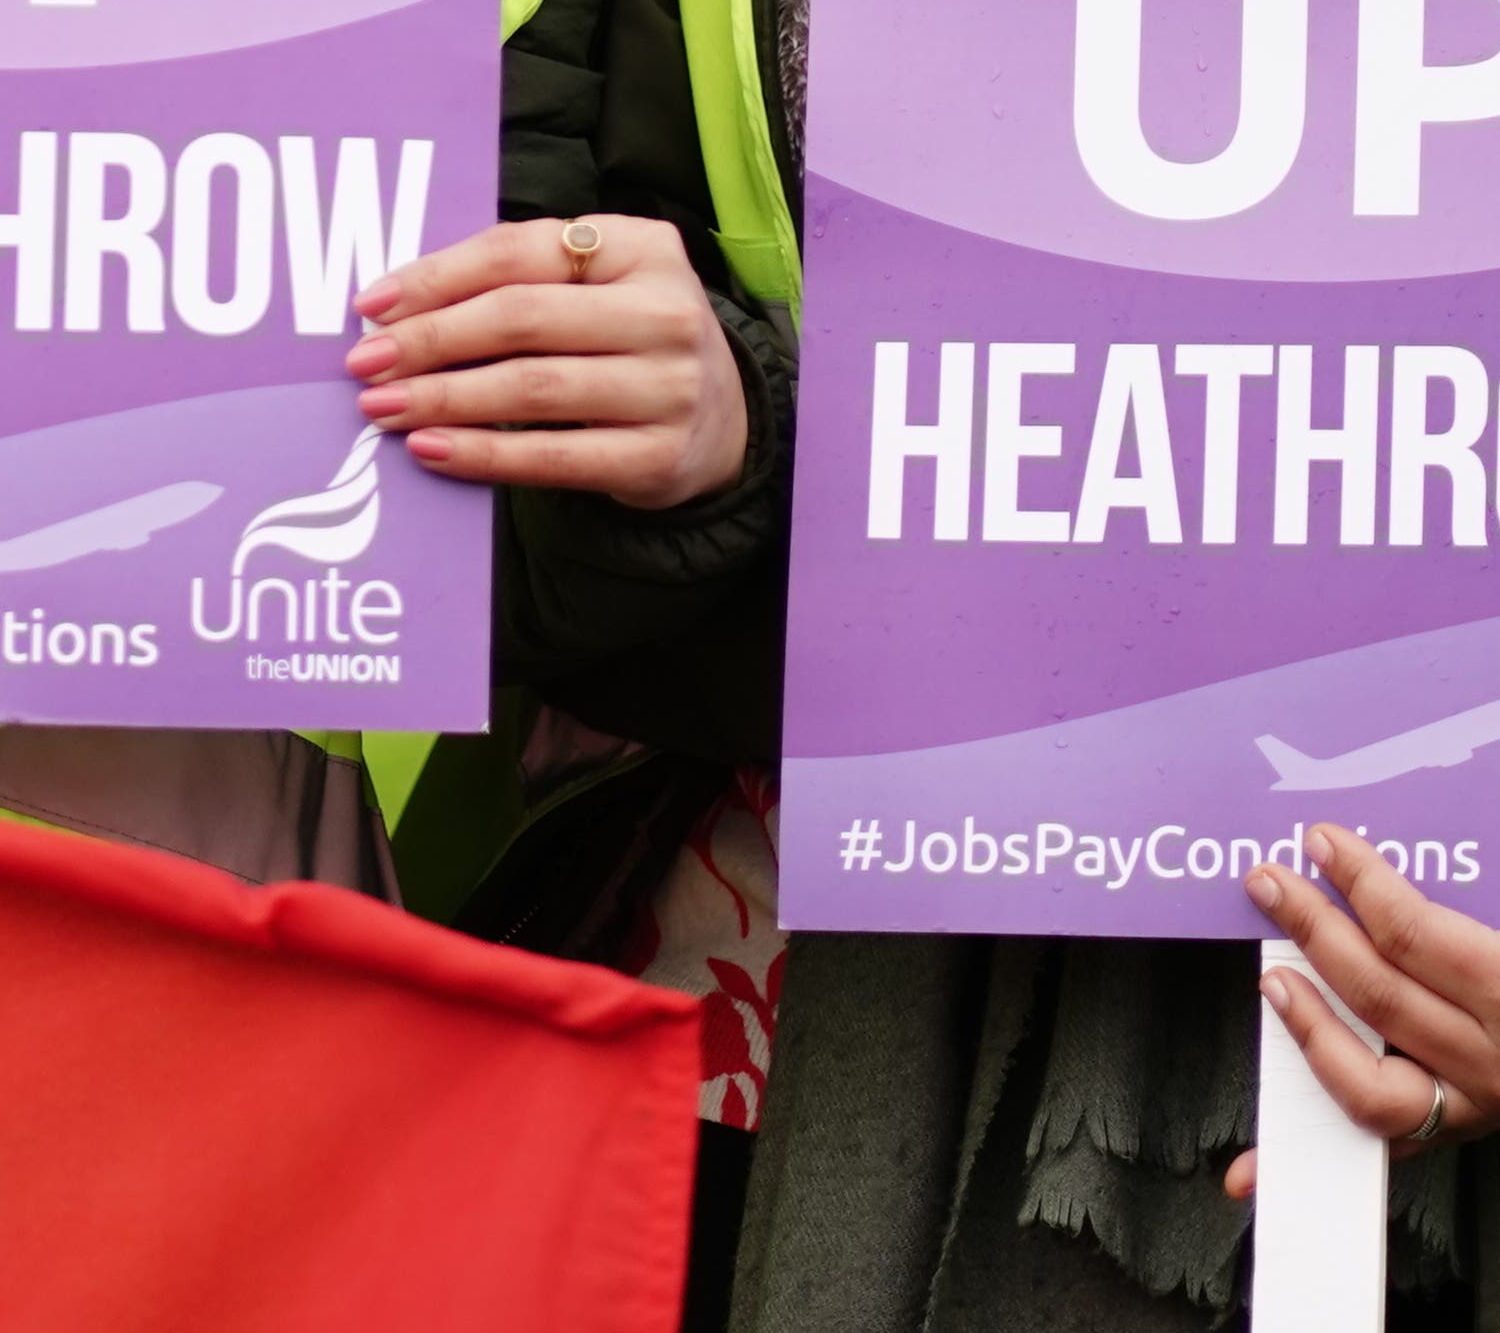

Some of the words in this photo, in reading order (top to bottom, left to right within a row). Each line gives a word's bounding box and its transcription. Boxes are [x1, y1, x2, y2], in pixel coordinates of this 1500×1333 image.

[192, 568, 401, 645] unite
[247, 653, 399, 683] theUNION
[840, 816, 1481, 889] #JobsPayCondons
